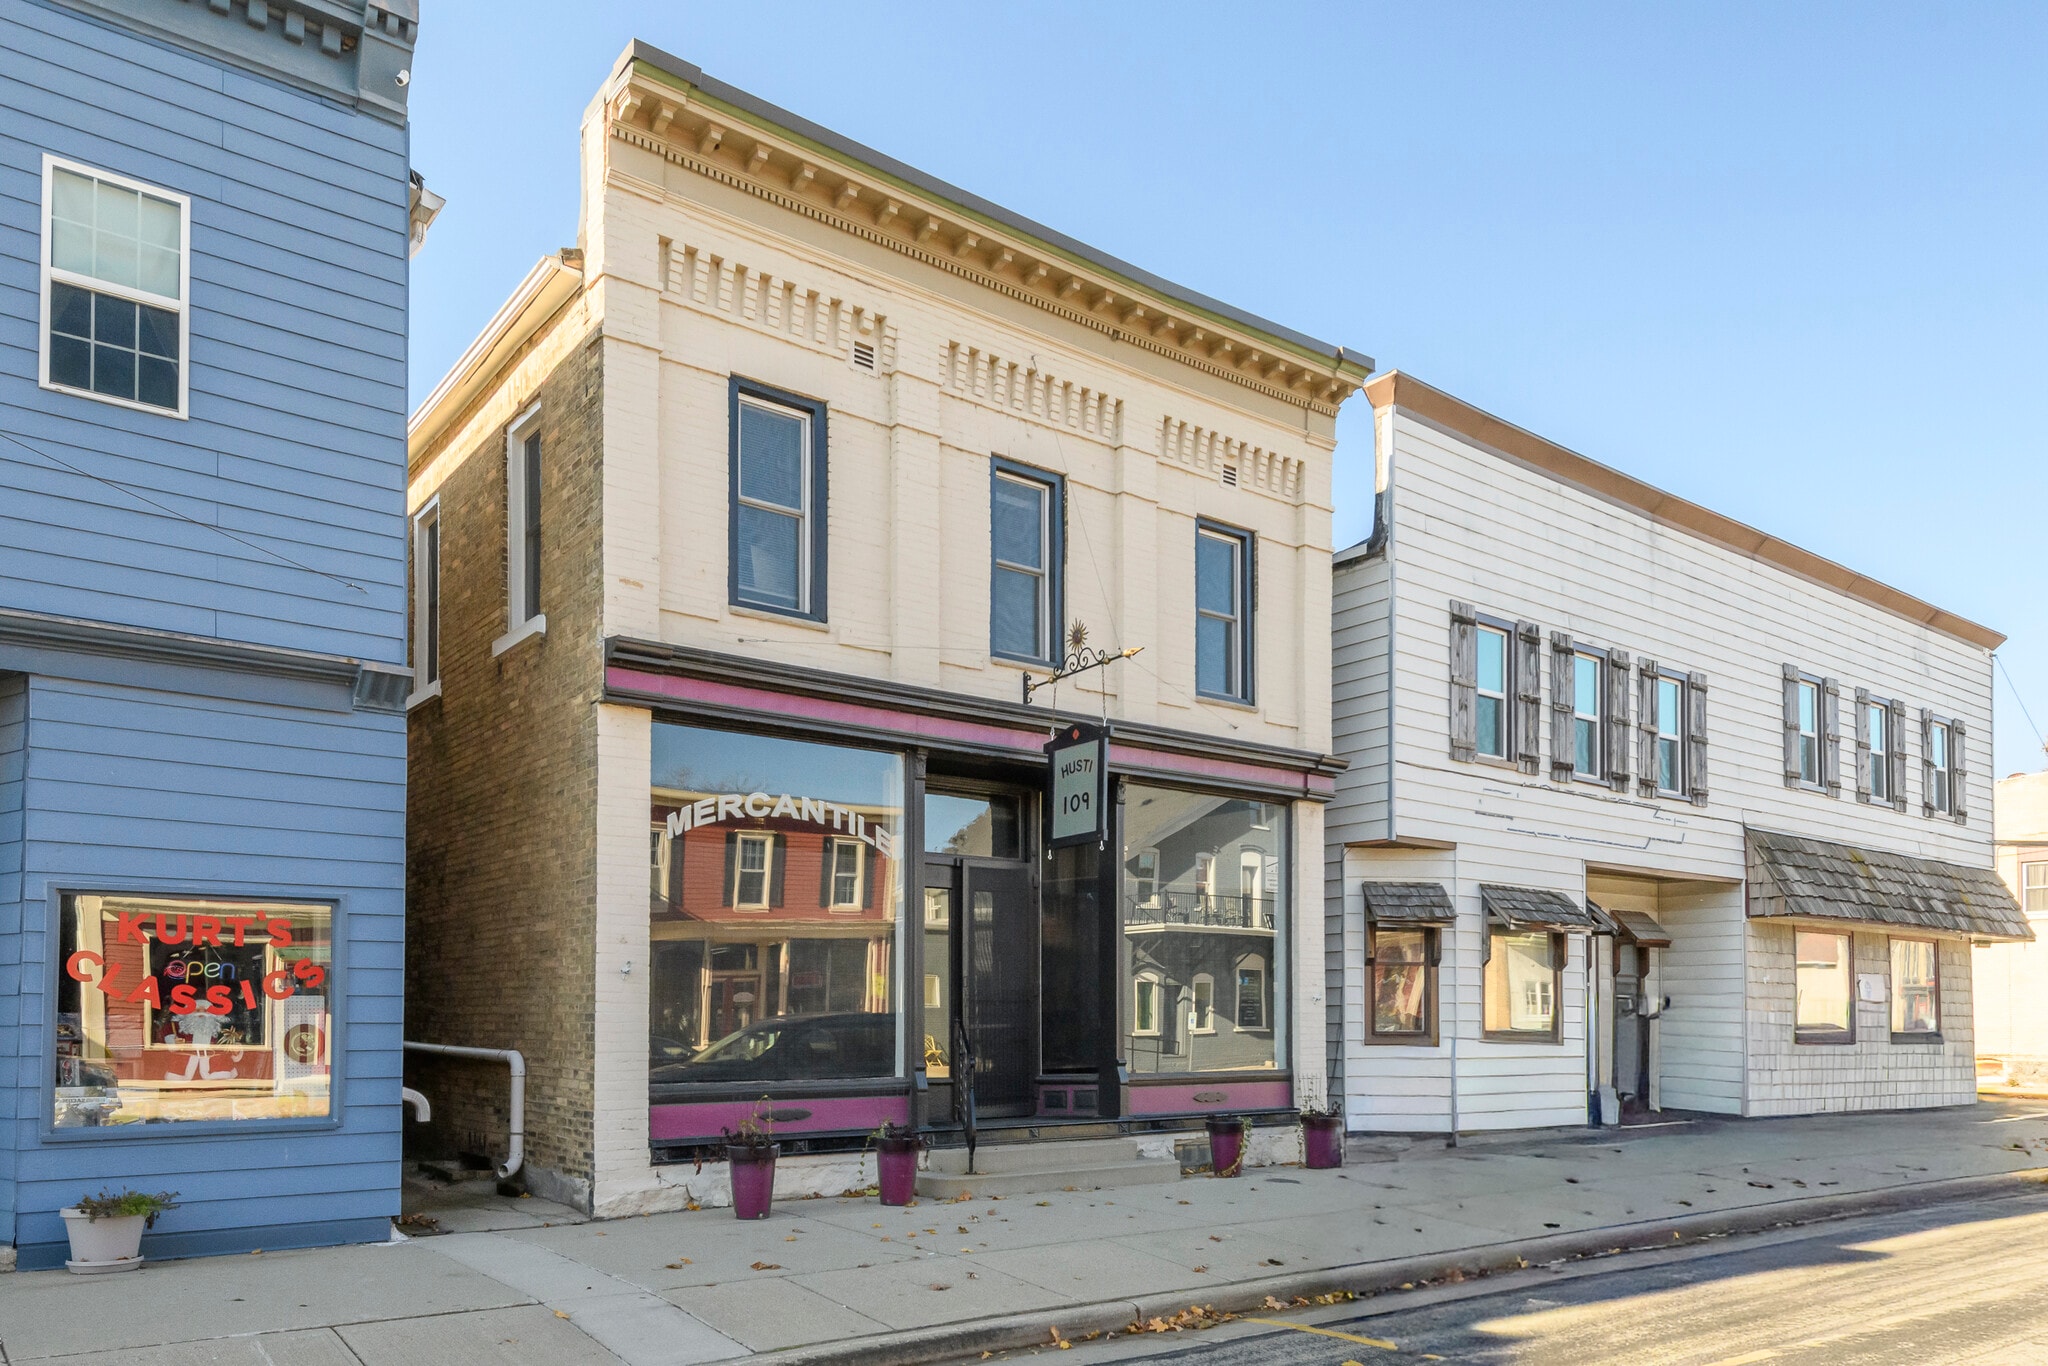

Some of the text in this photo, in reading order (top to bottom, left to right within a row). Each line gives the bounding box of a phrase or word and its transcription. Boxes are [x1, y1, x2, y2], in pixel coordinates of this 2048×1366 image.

[1061, 759, 1093, 779] HUSTI
[1063, 792, 1090, 815] 109
[666, 792, 892, 858] MERCANTILE
[117, 910, 292, 948] KURT'S
[66, 950, 325, 1016] CLASSICS
